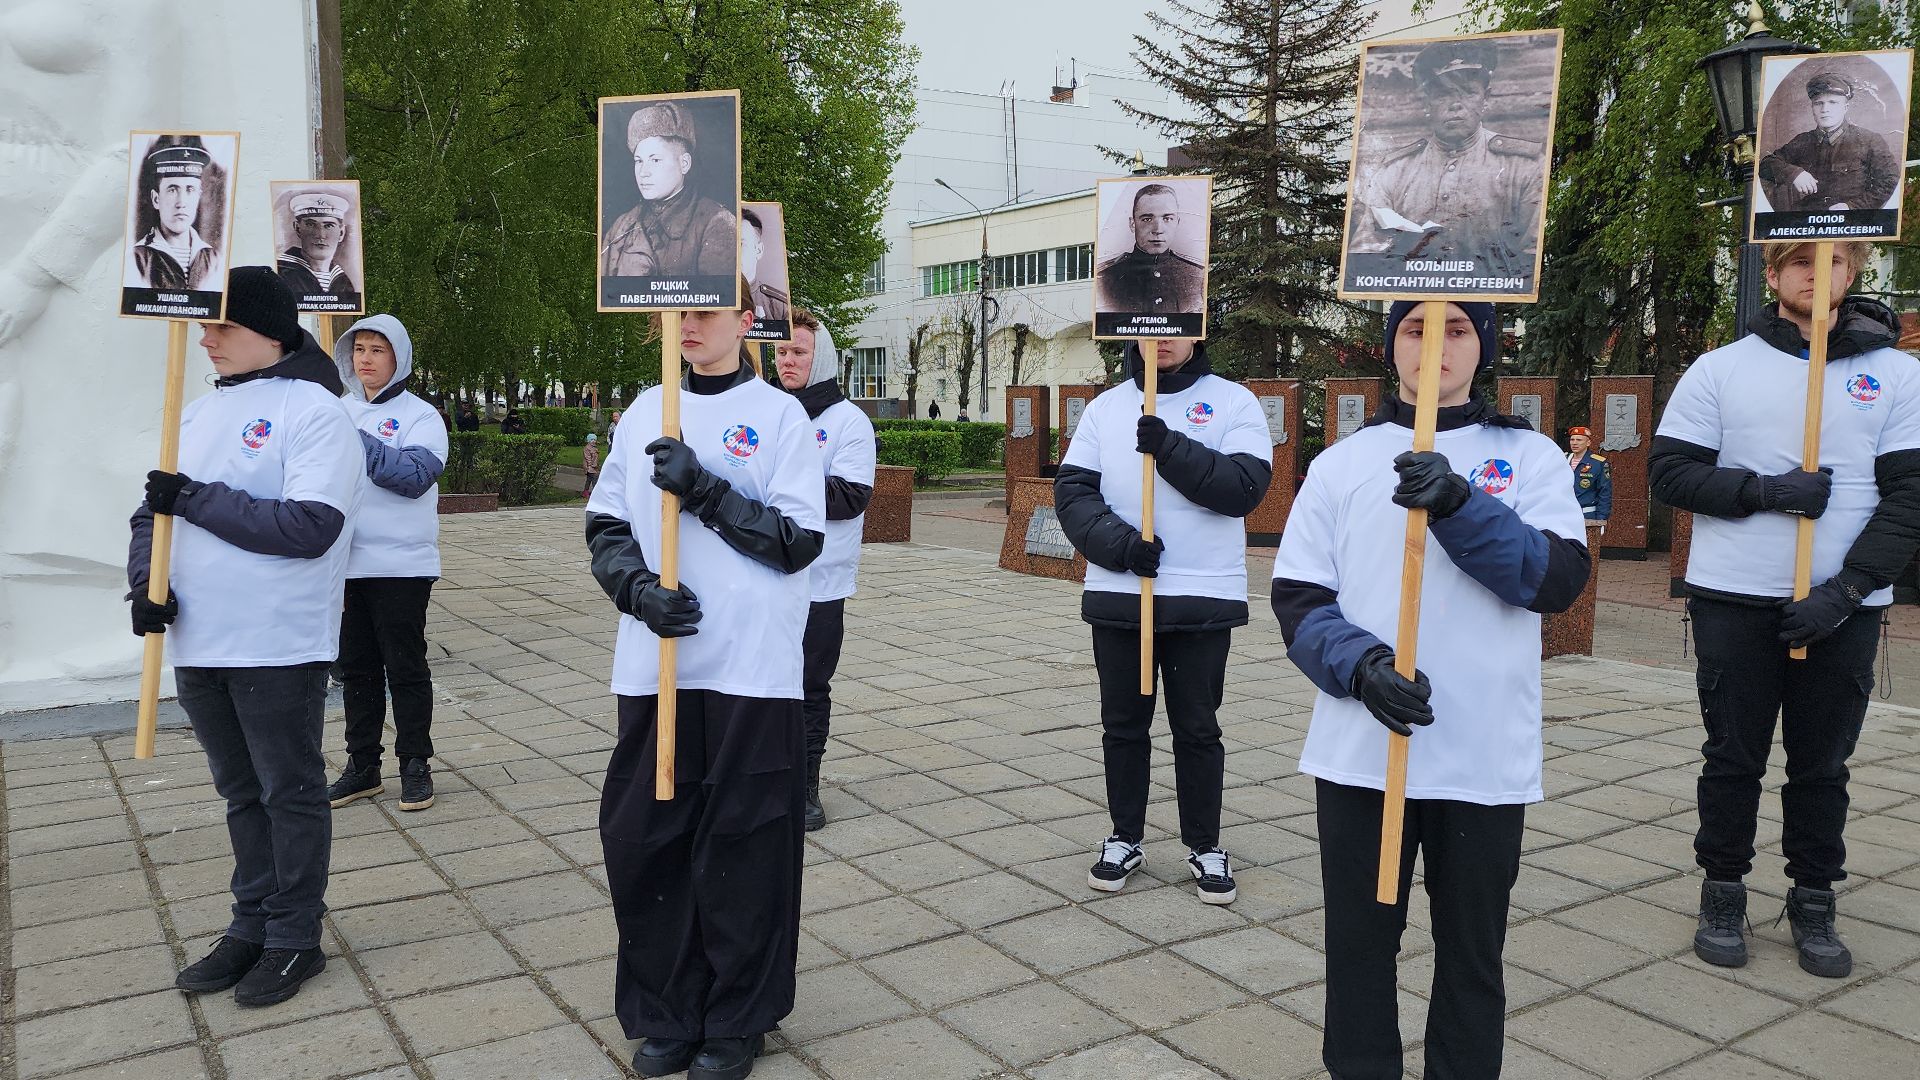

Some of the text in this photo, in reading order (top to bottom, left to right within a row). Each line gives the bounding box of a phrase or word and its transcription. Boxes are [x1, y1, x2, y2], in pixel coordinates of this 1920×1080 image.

[1808, 215, 1845, 223] ПОПОВ
[1769, 226, 1883, 235] АЛЕКСЕЙ АЛЕКСЕЕВИЧ
[1405, 260, 1474, 271] КОЛЫШЕВ
[650, 281, 689, 291] БУЦКИХ
[1356, 276, 1524, 288] КОНСТАНТИН СЕРГЕЕВИЧ
[157, 293, 189, 303] УШАКОВ
[620, 294, 720, 304] ПАВЕЛ НИКОЛАЕВИЧ
[135, 304, 209, 316] МИХАИЛ ИВАНОВИЧ
[1116, 326, 1182, 334] ИВАН ИВАНОВИЧ
